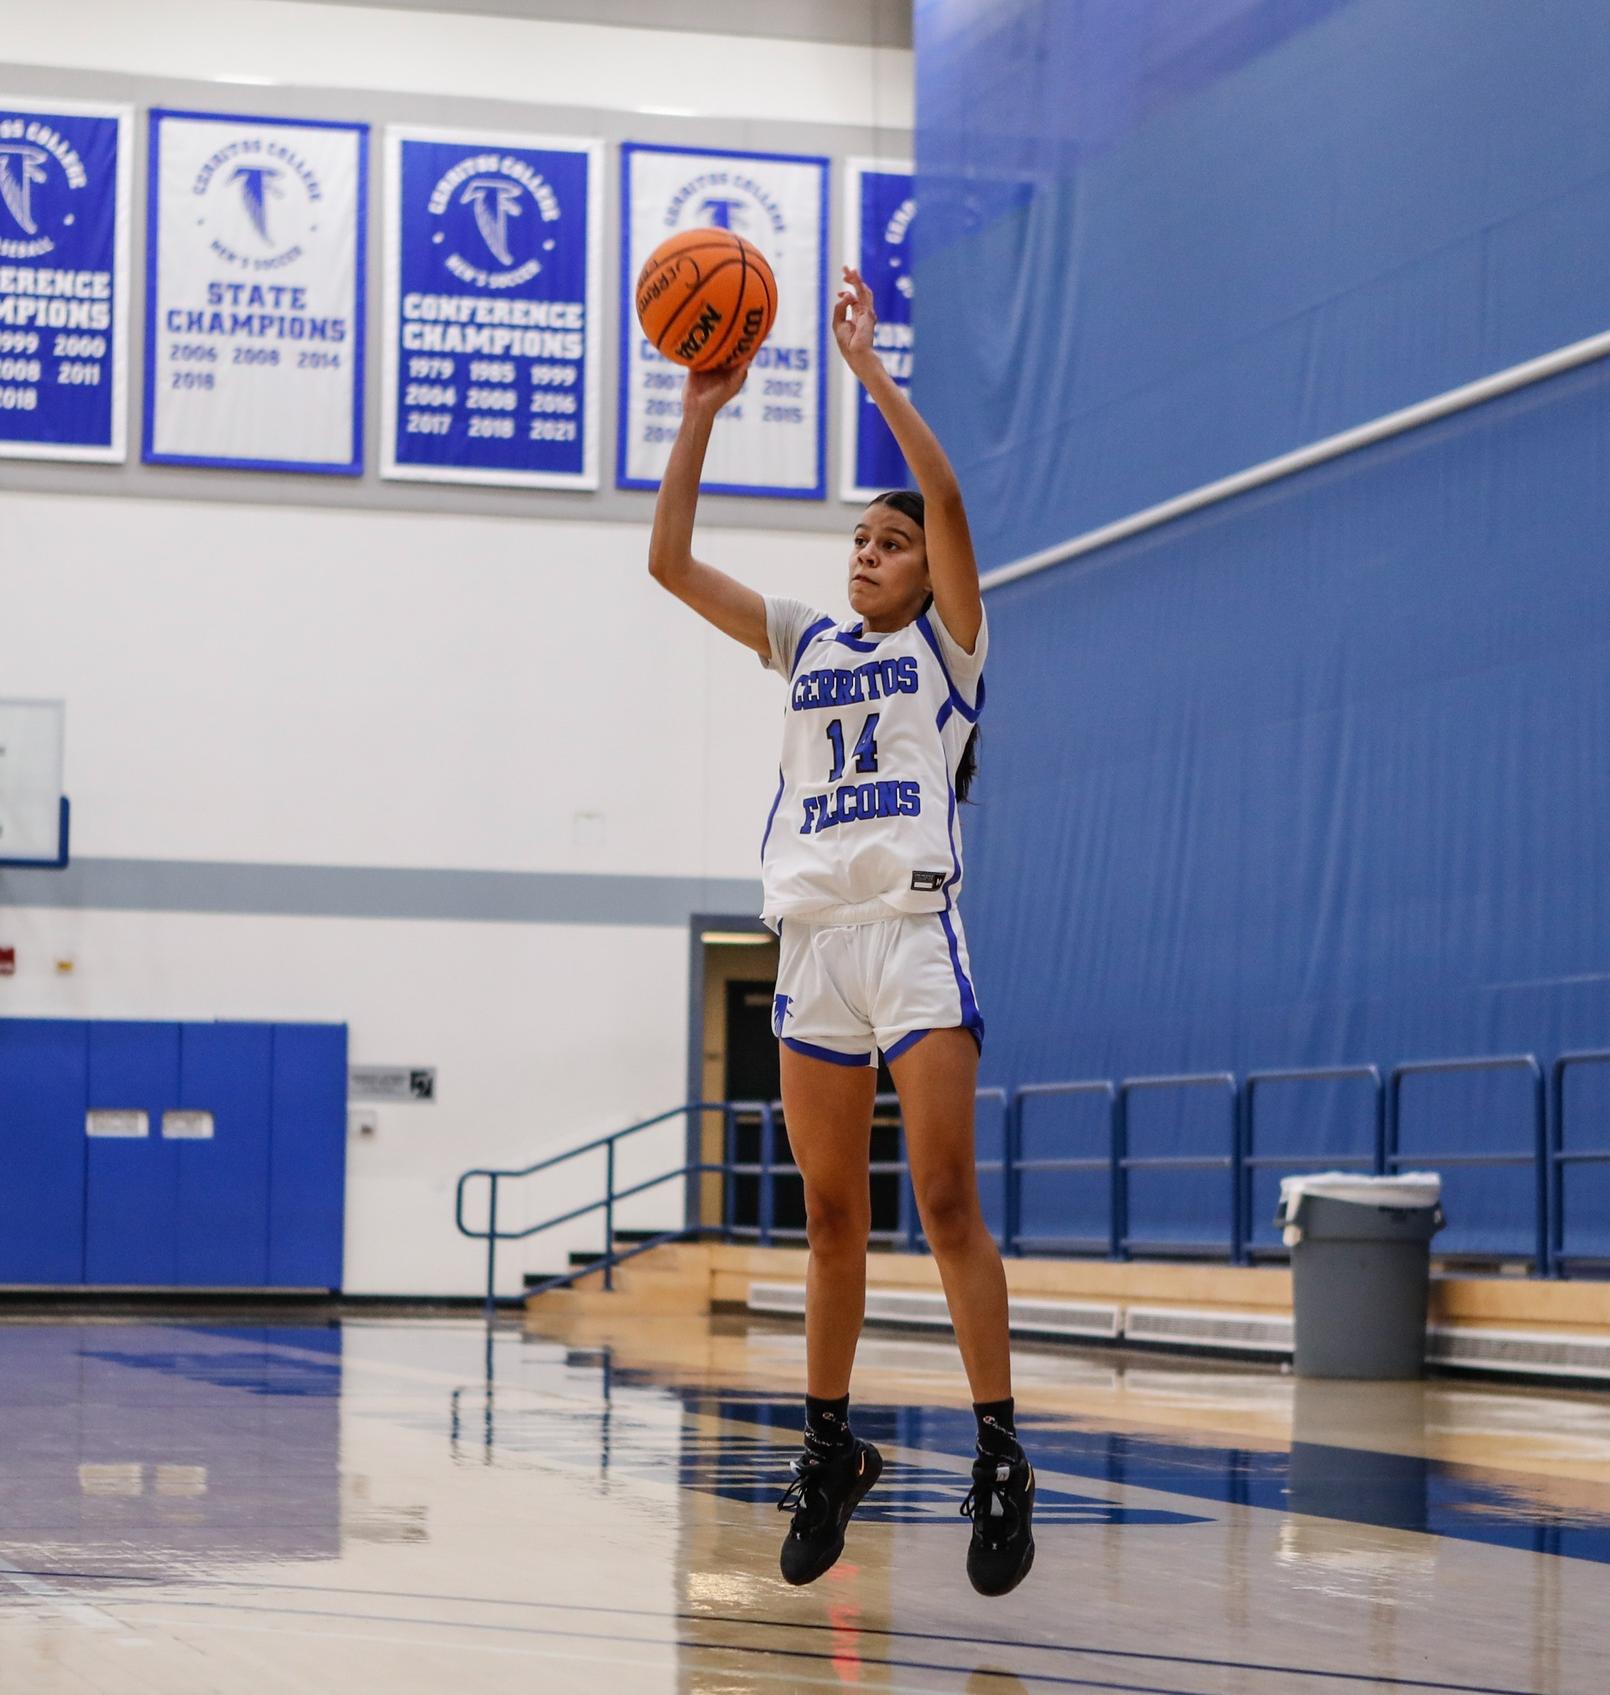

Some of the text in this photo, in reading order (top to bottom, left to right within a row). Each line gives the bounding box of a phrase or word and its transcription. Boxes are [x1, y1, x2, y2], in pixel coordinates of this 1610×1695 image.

[428, 154, 560, 222] CERRITOS COLLEGE
[207, 282, 307, 311] STATE
[403, 293, 583, 329] CONFERENCE
[167, 310, 347, 342] CHAMPIONS
[402, 323, 583, 360] CHAMPIONS
[674, 303, 722, 360] NCAA
[53, 332, 107, 358] 2000
[170, 344, 218, 363] 2006
[297, 352, 341, 369] 2014
[0, 356, 101, 386] 008 2011
[172, 372, 215, 391] 2018
[409, 356, 455, 380] 1979
[530, 365, 577, 387] 1999
[0, 385, 37, 411] 018
[407, 411, 453, 435] 2017
[530, 418, 577, 441] 2021
[792, 656, 918, 711] CERRITOS
[826, 713, 880, 782] 14
